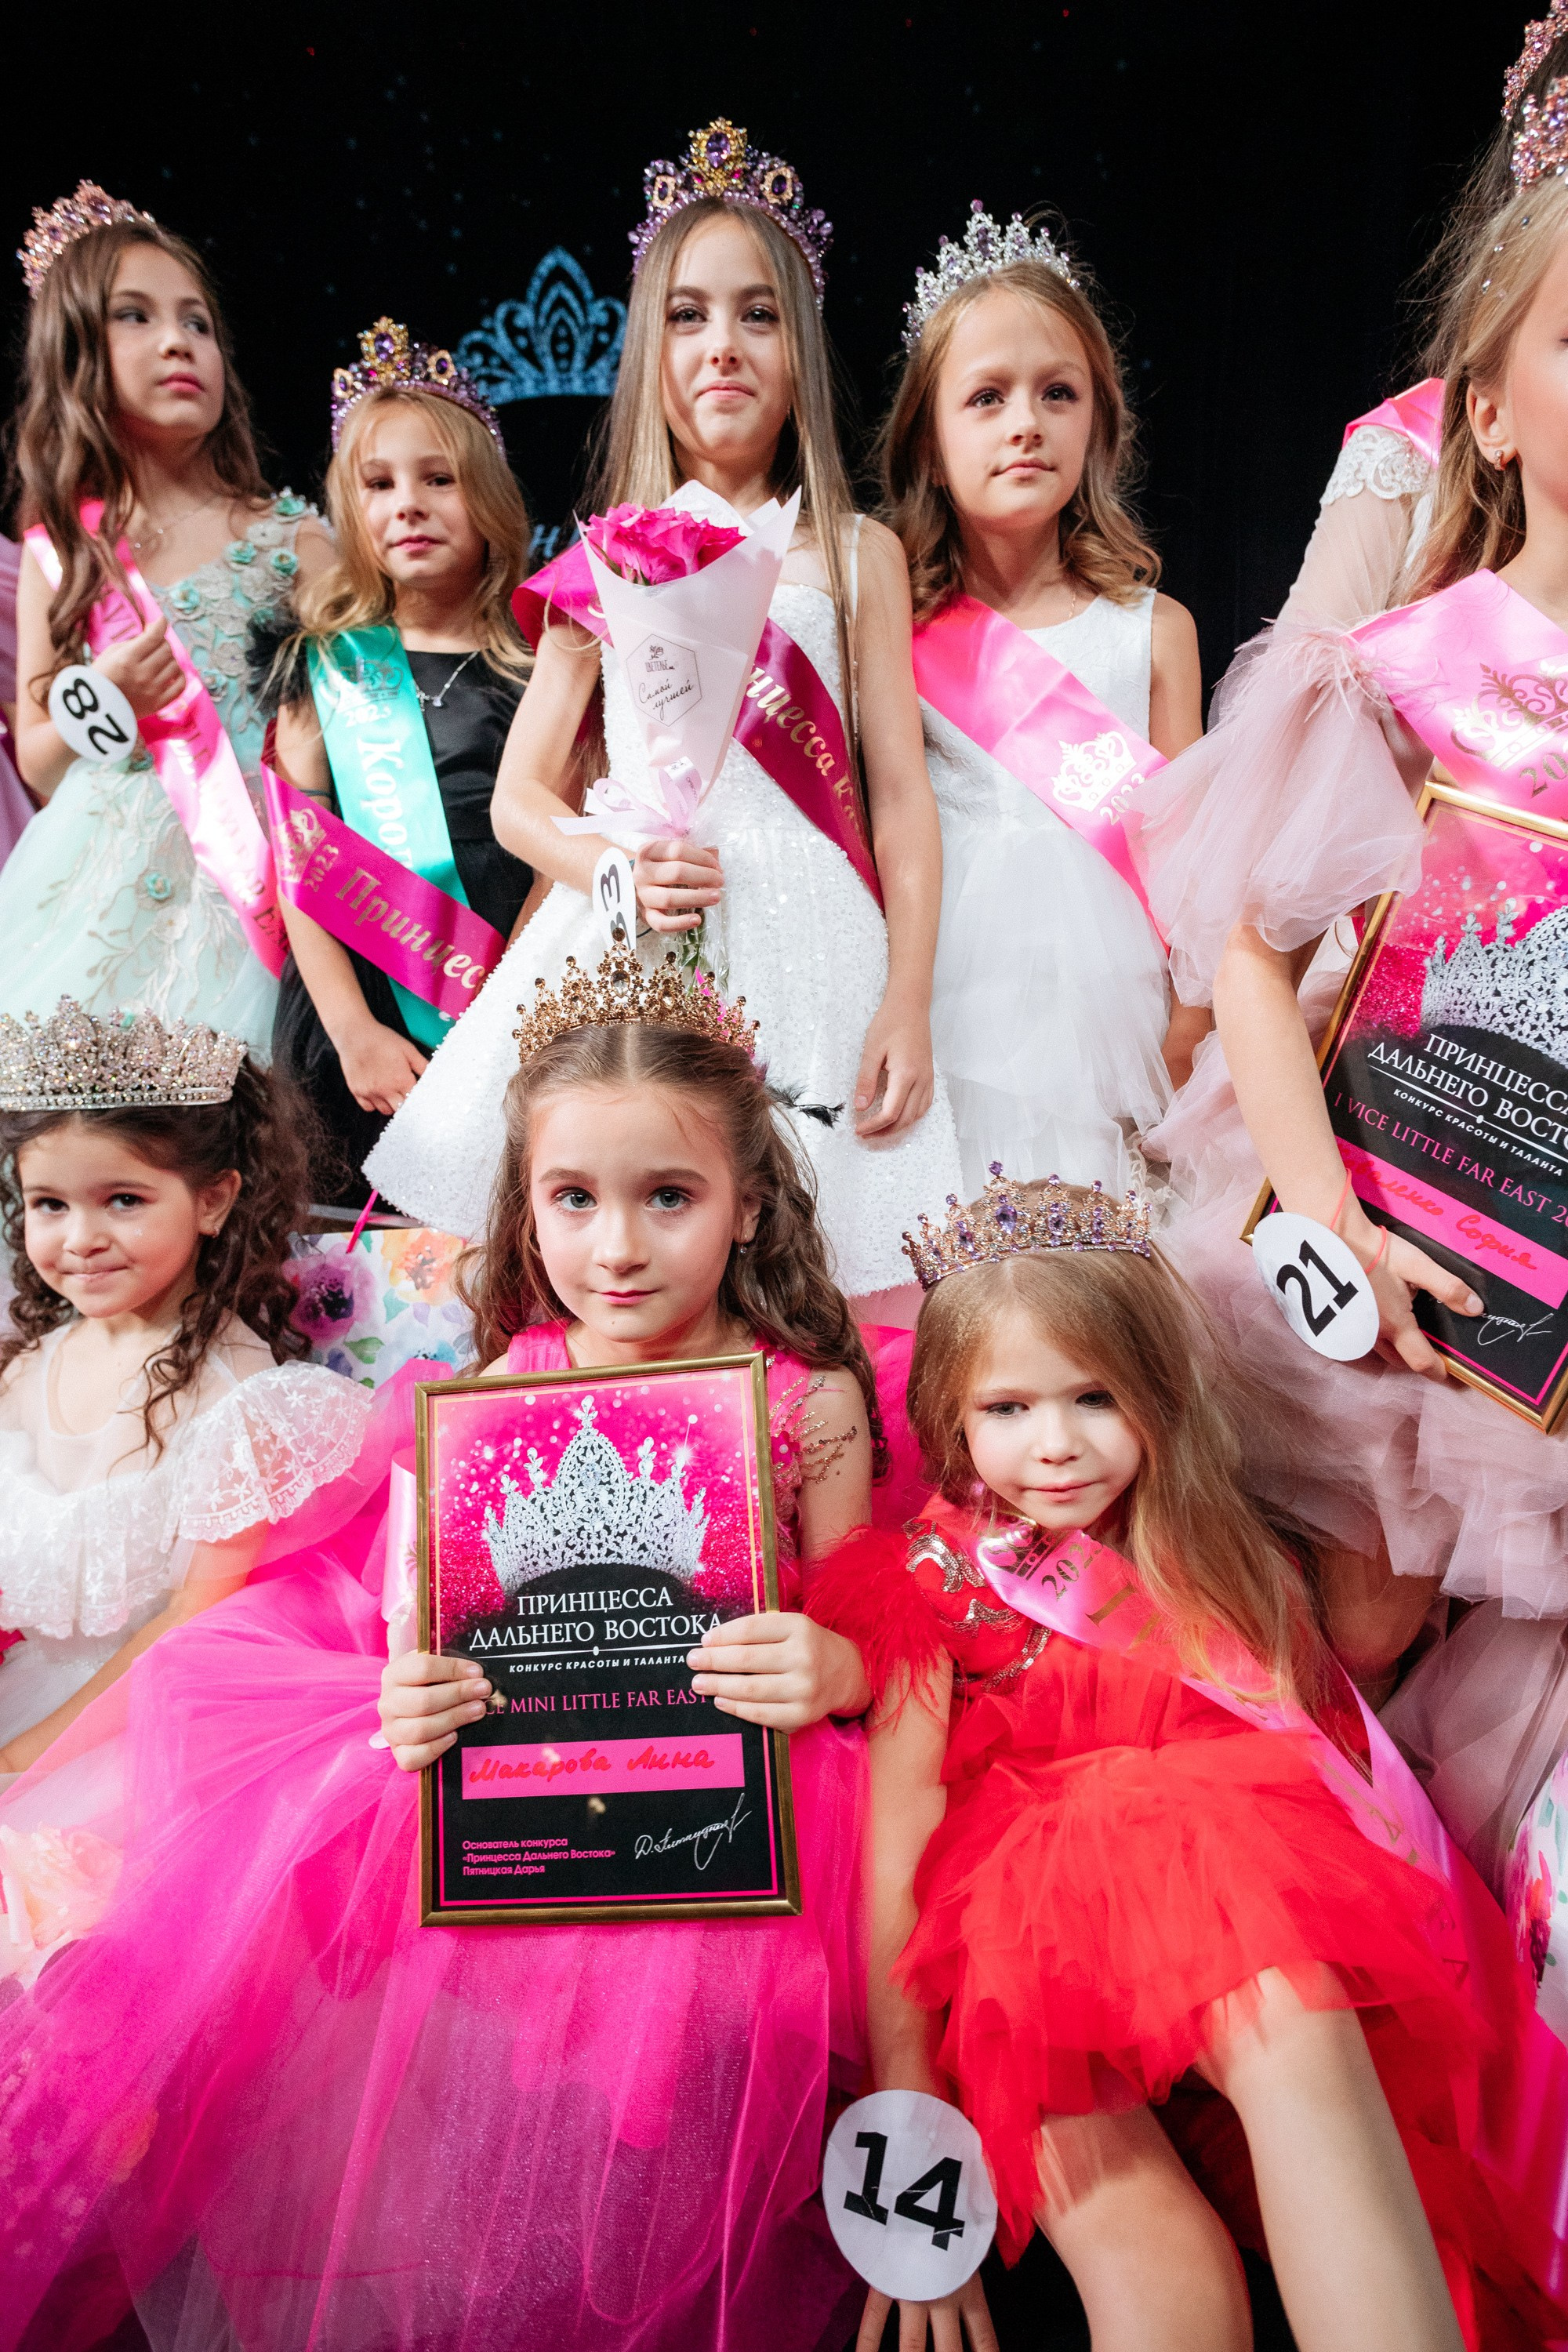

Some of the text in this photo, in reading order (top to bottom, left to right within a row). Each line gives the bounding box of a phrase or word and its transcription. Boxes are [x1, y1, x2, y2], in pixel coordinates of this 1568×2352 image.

[639, 678, 673, 703] Самой
[62, 678, 129, 755] 28
[1367, 1042, 1568, 1152] ДАЛЬНЕГО ВОСТ
[1393, 1088, 1563, 1177] КОНКУРС КРАСОТЫ И ТАЛАНТА
[1347, 1098, 1389, 1131] VICE
[1391, 1122, 1454, 1165] LITTLE
[1457, 1155, 1496, 1189] FAR
[1499, 1178, 1552, 1214] EAST
[1456, 1214, 1537, 1270] София
[1276, 1240, 1359, 1337] 21
[517, 1586, 673, 1616] ПРИНЦЕССА
[469, 1621, 595, 1651] ДАЛЬНЕГО
[510, 1655, 686, 1673] КОНКУРС КРАСОТЫ И ТАЛАНТА
[510, 1696, 556, 1714] MINI
[562, 1692, 621, 1711] LITTLE
[627, 1690, 663, 1707] FAR
[469, 1745, 715, 1782] Макарова Анна
[462, 1849, 616, 1864] «Принцесса Дальнего Востока»
[463, 1838, 568, 1850] Основатель конкурса
[463, 1864, 546, 1876] Пятницкая Дарья
[843, 2130, 966, 2252] 14
